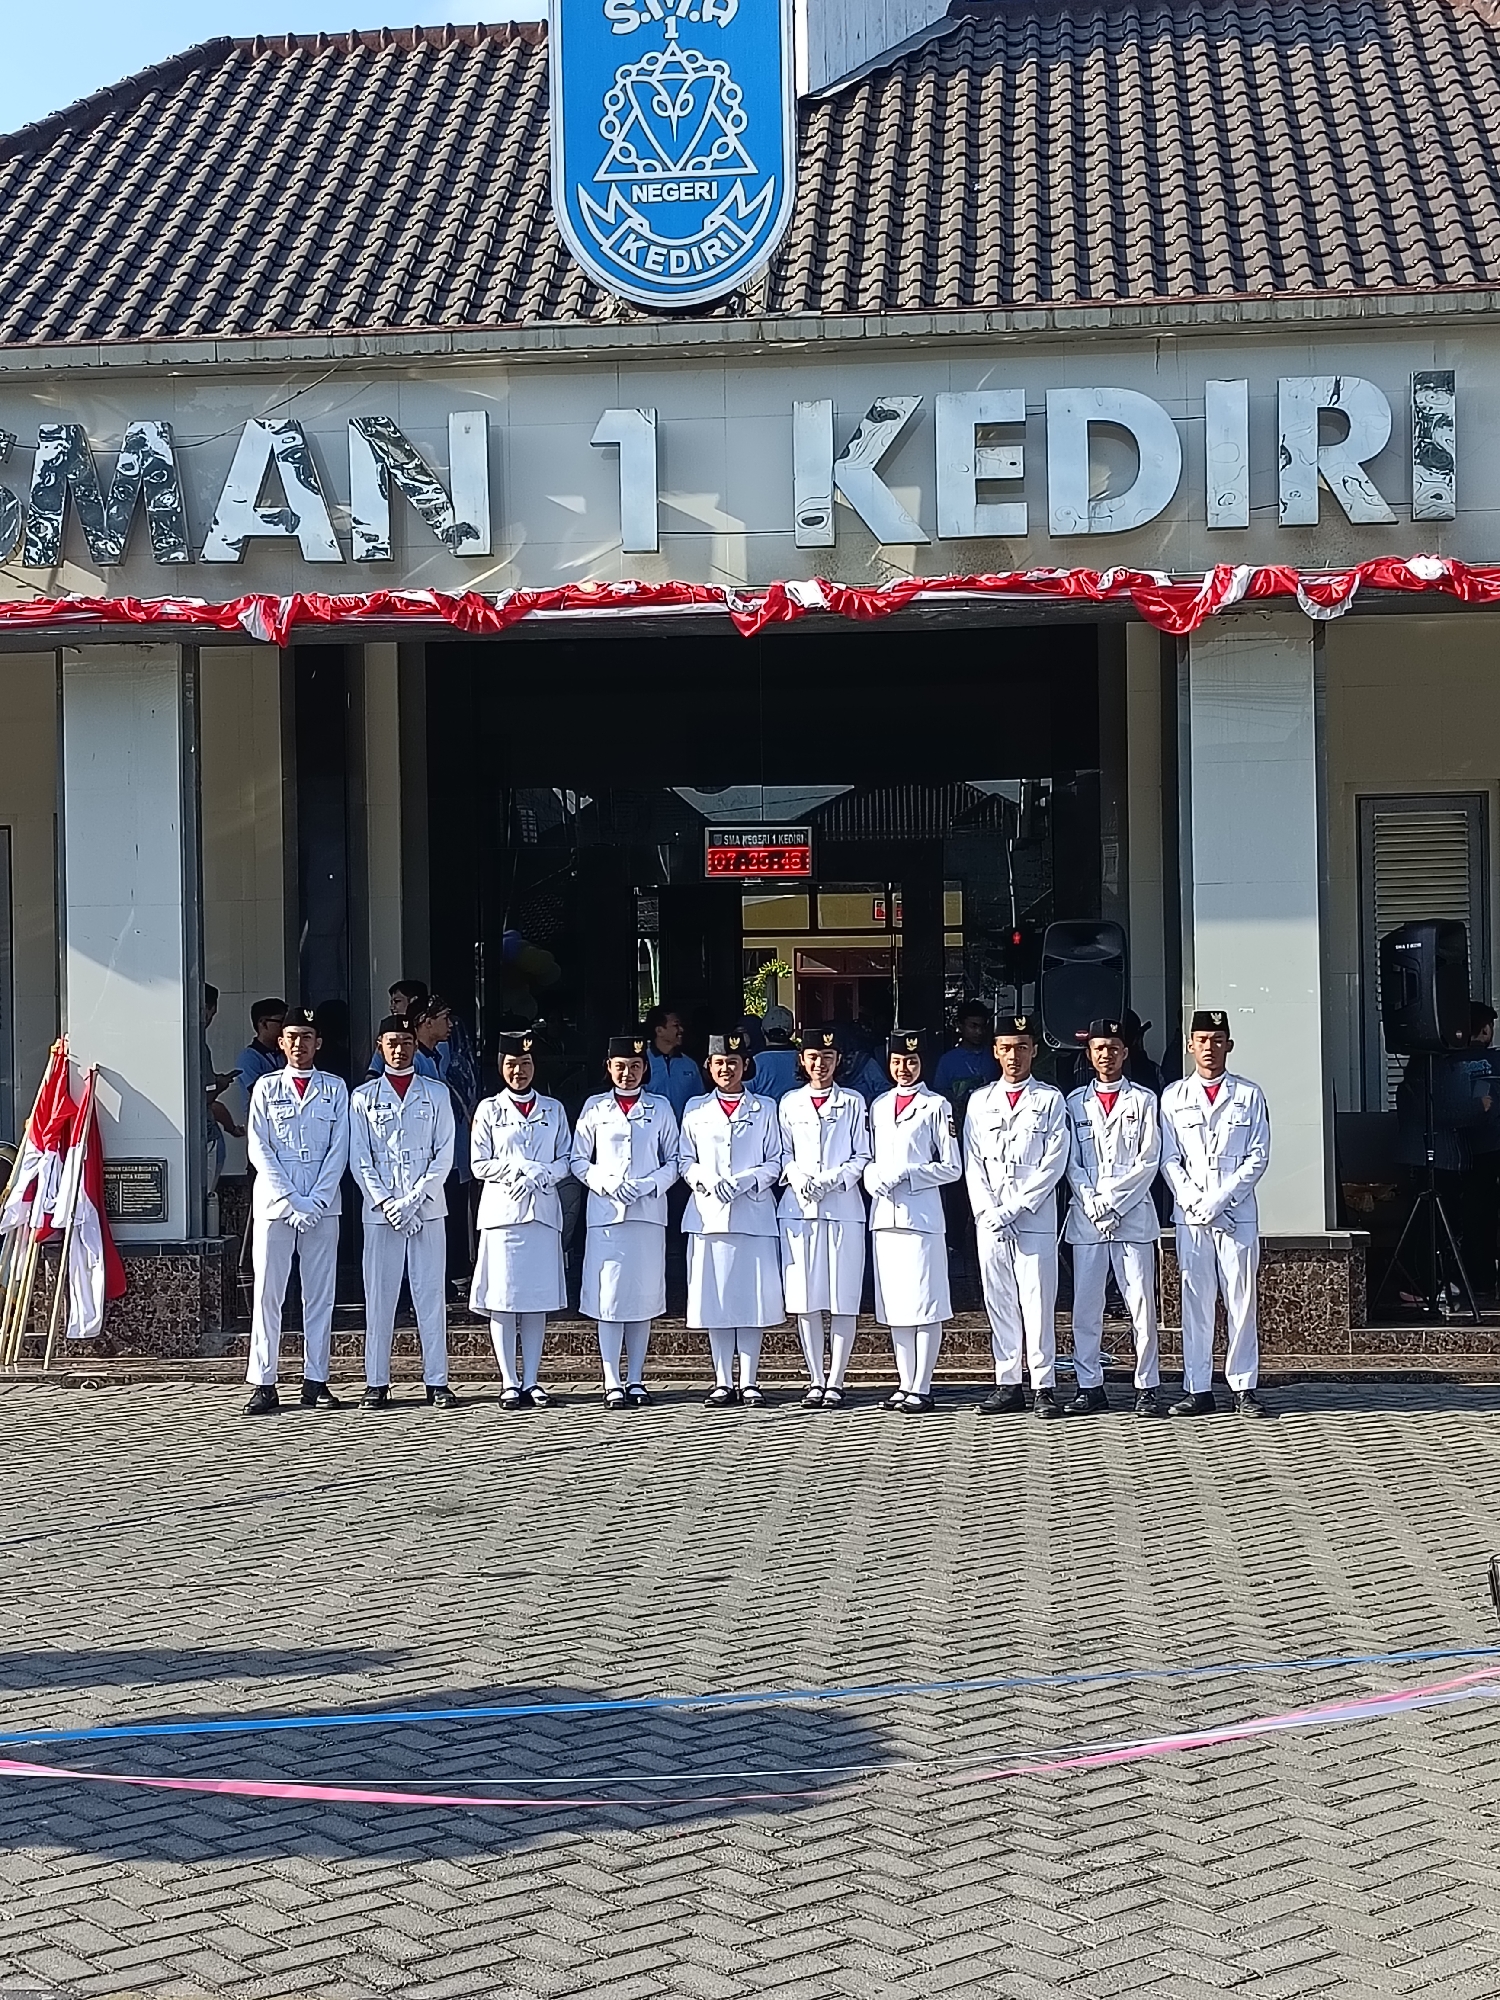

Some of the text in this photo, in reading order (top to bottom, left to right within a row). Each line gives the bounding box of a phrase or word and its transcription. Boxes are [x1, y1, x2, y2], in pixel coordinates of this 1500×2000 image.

[664, 15, 679, 39] 1
[631, 181, 718, 203] NEGERI
[618, 229, 739, 275] KEDIRI
[589, 407, 660, 555] 1
[793, 369, 1456, 549] KEDIRI
[723, 833, 741, 846] SMA
[772, 833, 777, 844] 1
[778, 833, 805, 845] KEDIRI
